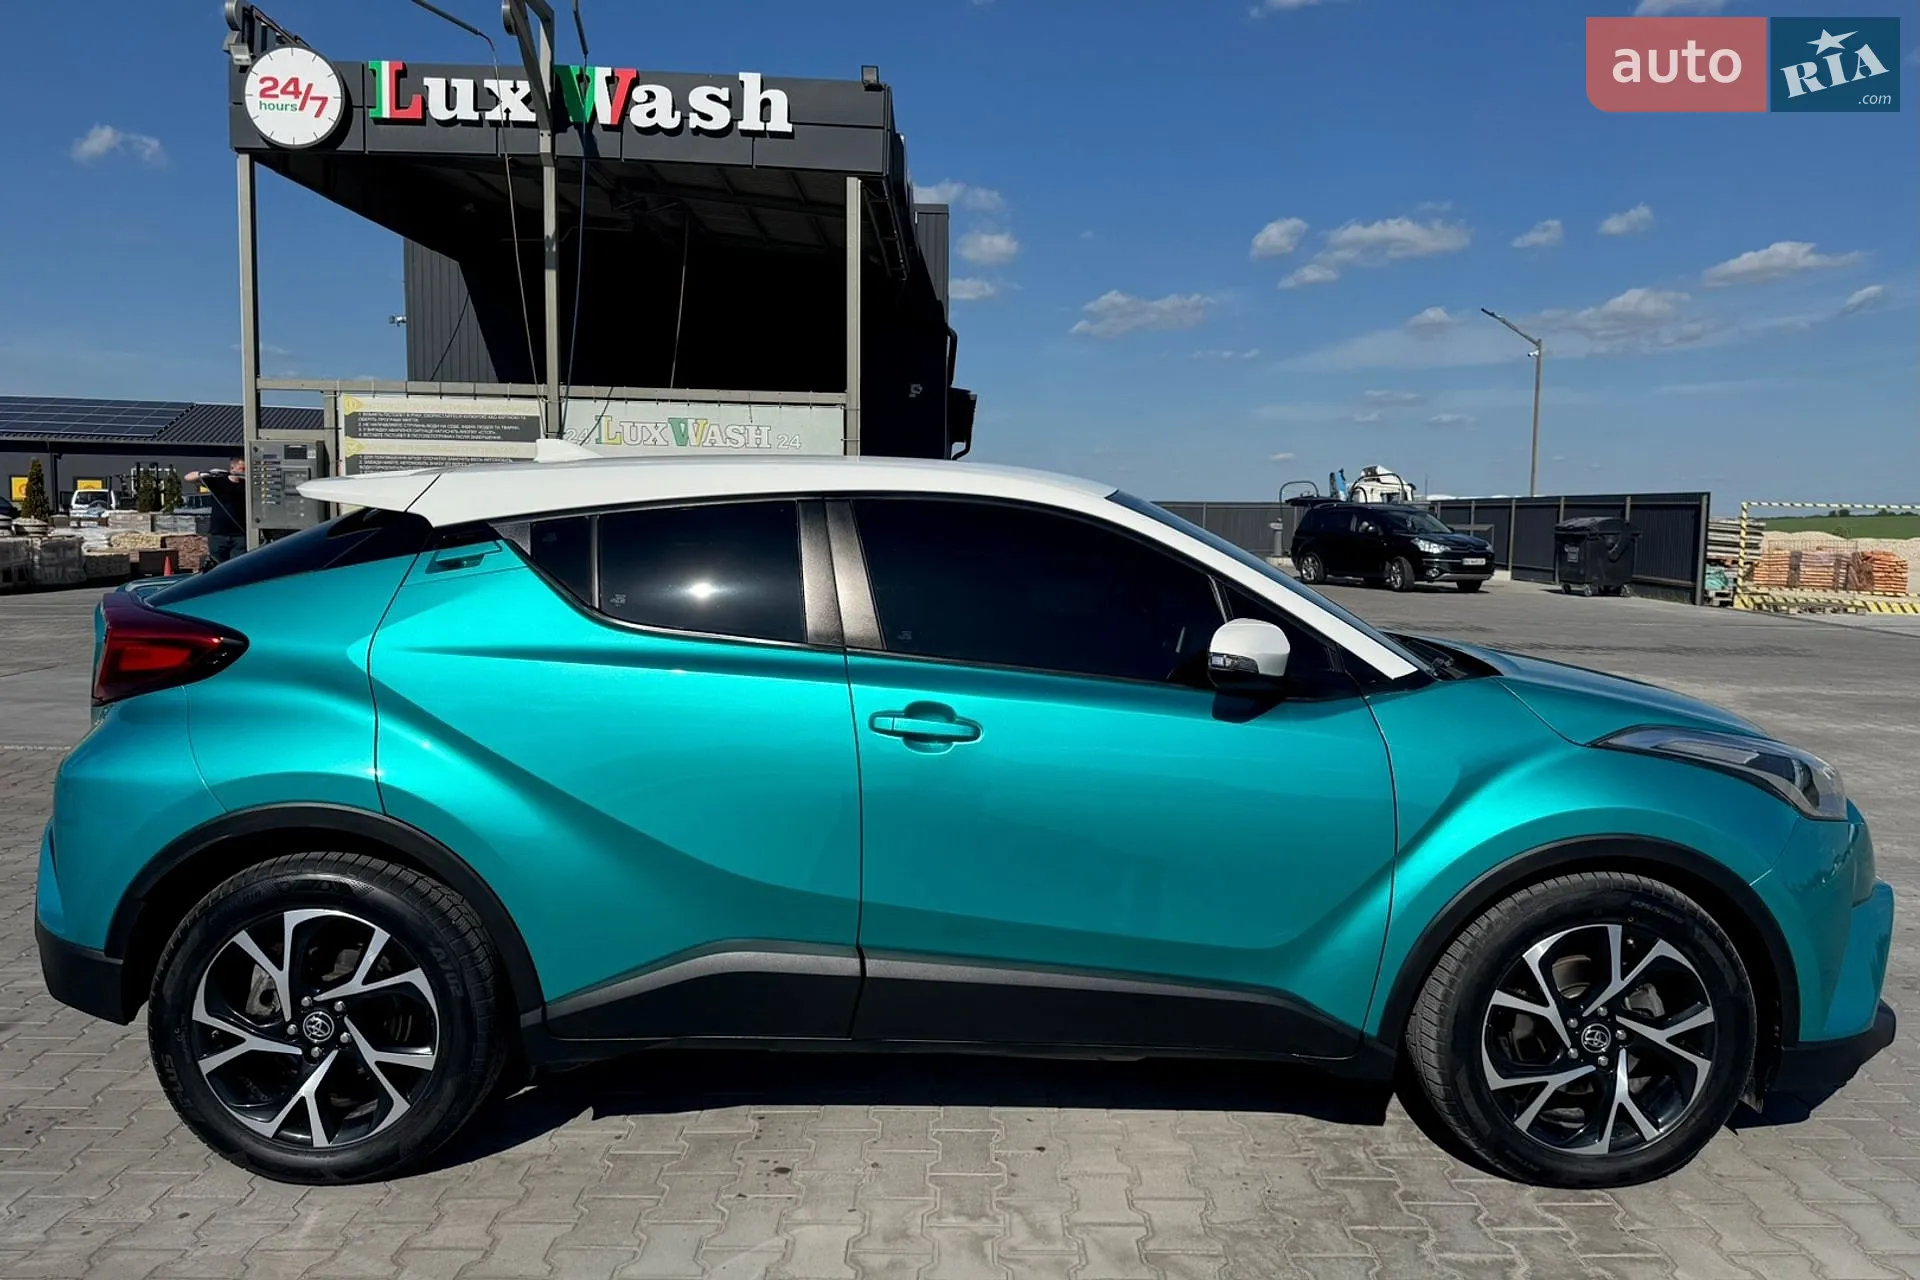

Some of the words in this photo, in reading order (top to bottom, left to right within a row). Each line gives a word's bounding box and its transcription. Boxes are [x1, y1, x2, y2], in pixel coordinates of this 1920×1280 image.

[258, 76, 328, 118] 24/7
[259, 100, 298, 112] hours
[777, 433, 802, 449] 24
